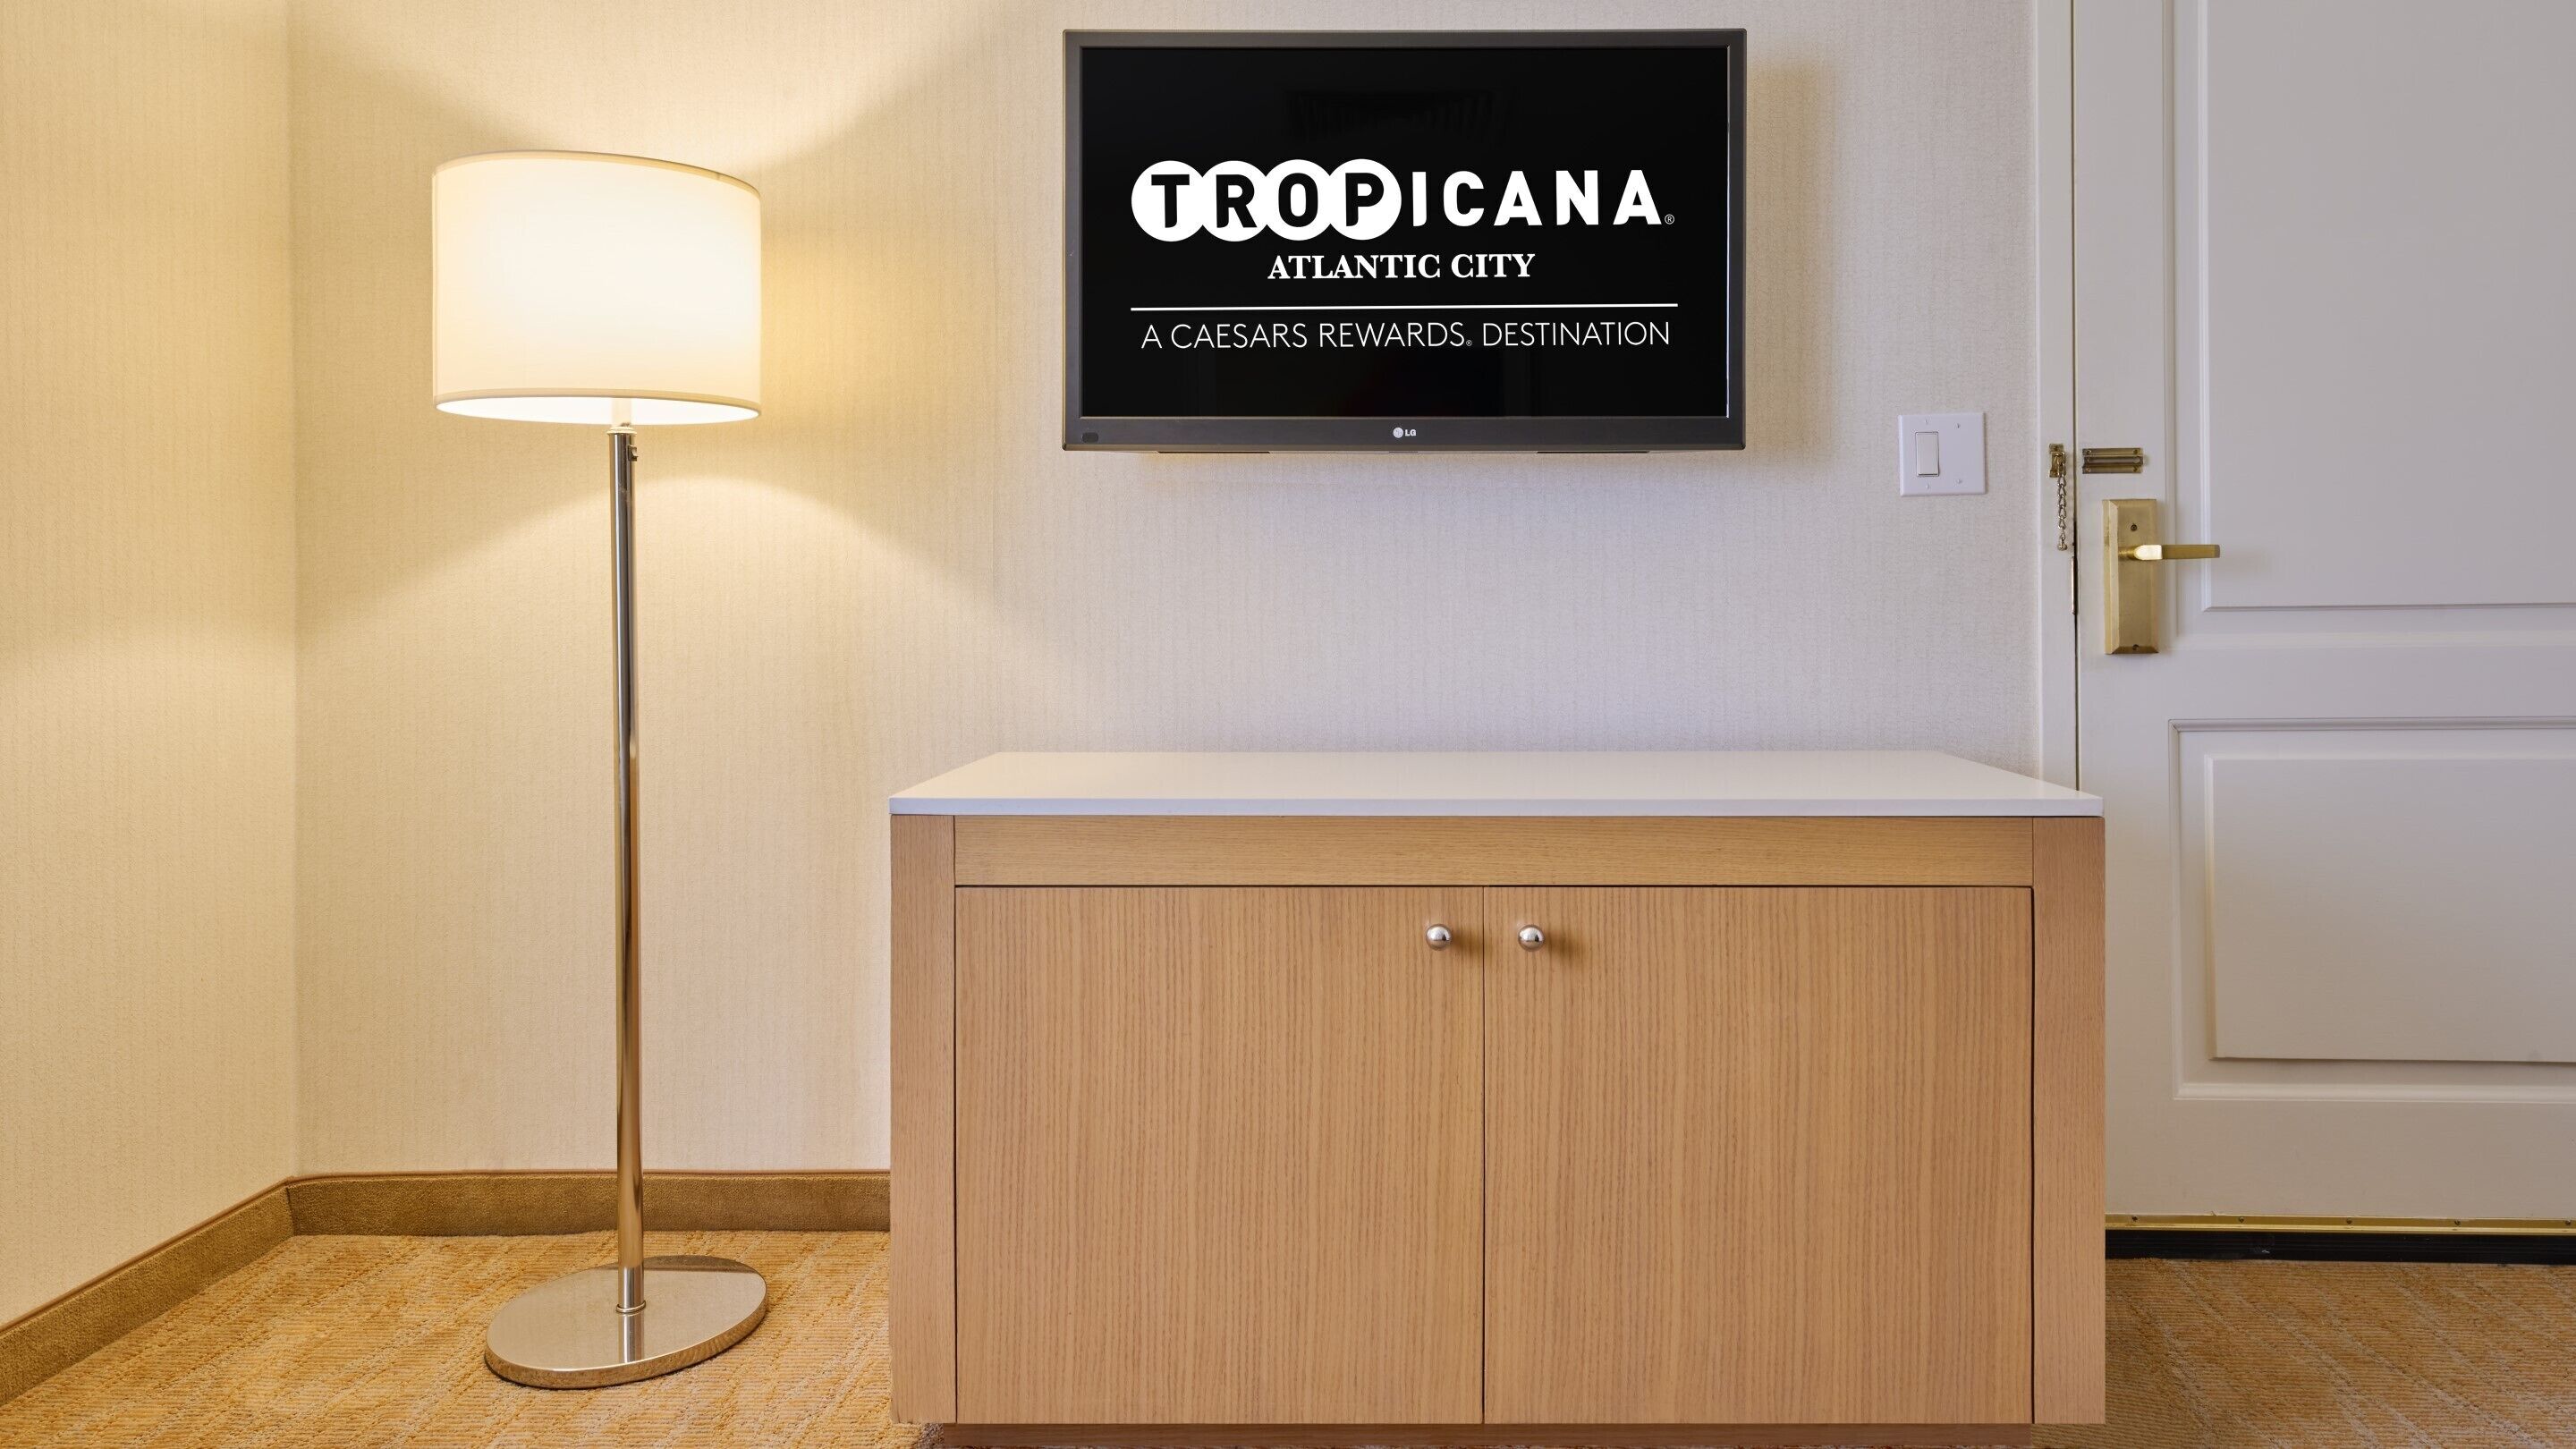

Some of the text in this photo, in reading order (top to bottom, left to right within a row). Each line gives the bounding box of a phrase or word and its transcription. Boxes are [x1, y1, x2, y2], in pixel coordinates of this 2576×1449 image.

[1267, 254, 1536, 280] ATLANTIC CITY
[1140, 324, 1163, 349] A
[1171, 323, 1308, 349] CAESARS
[1483, 321, 1669, 347] DESTINATION
[1404, 428, 1417, 437] LG
